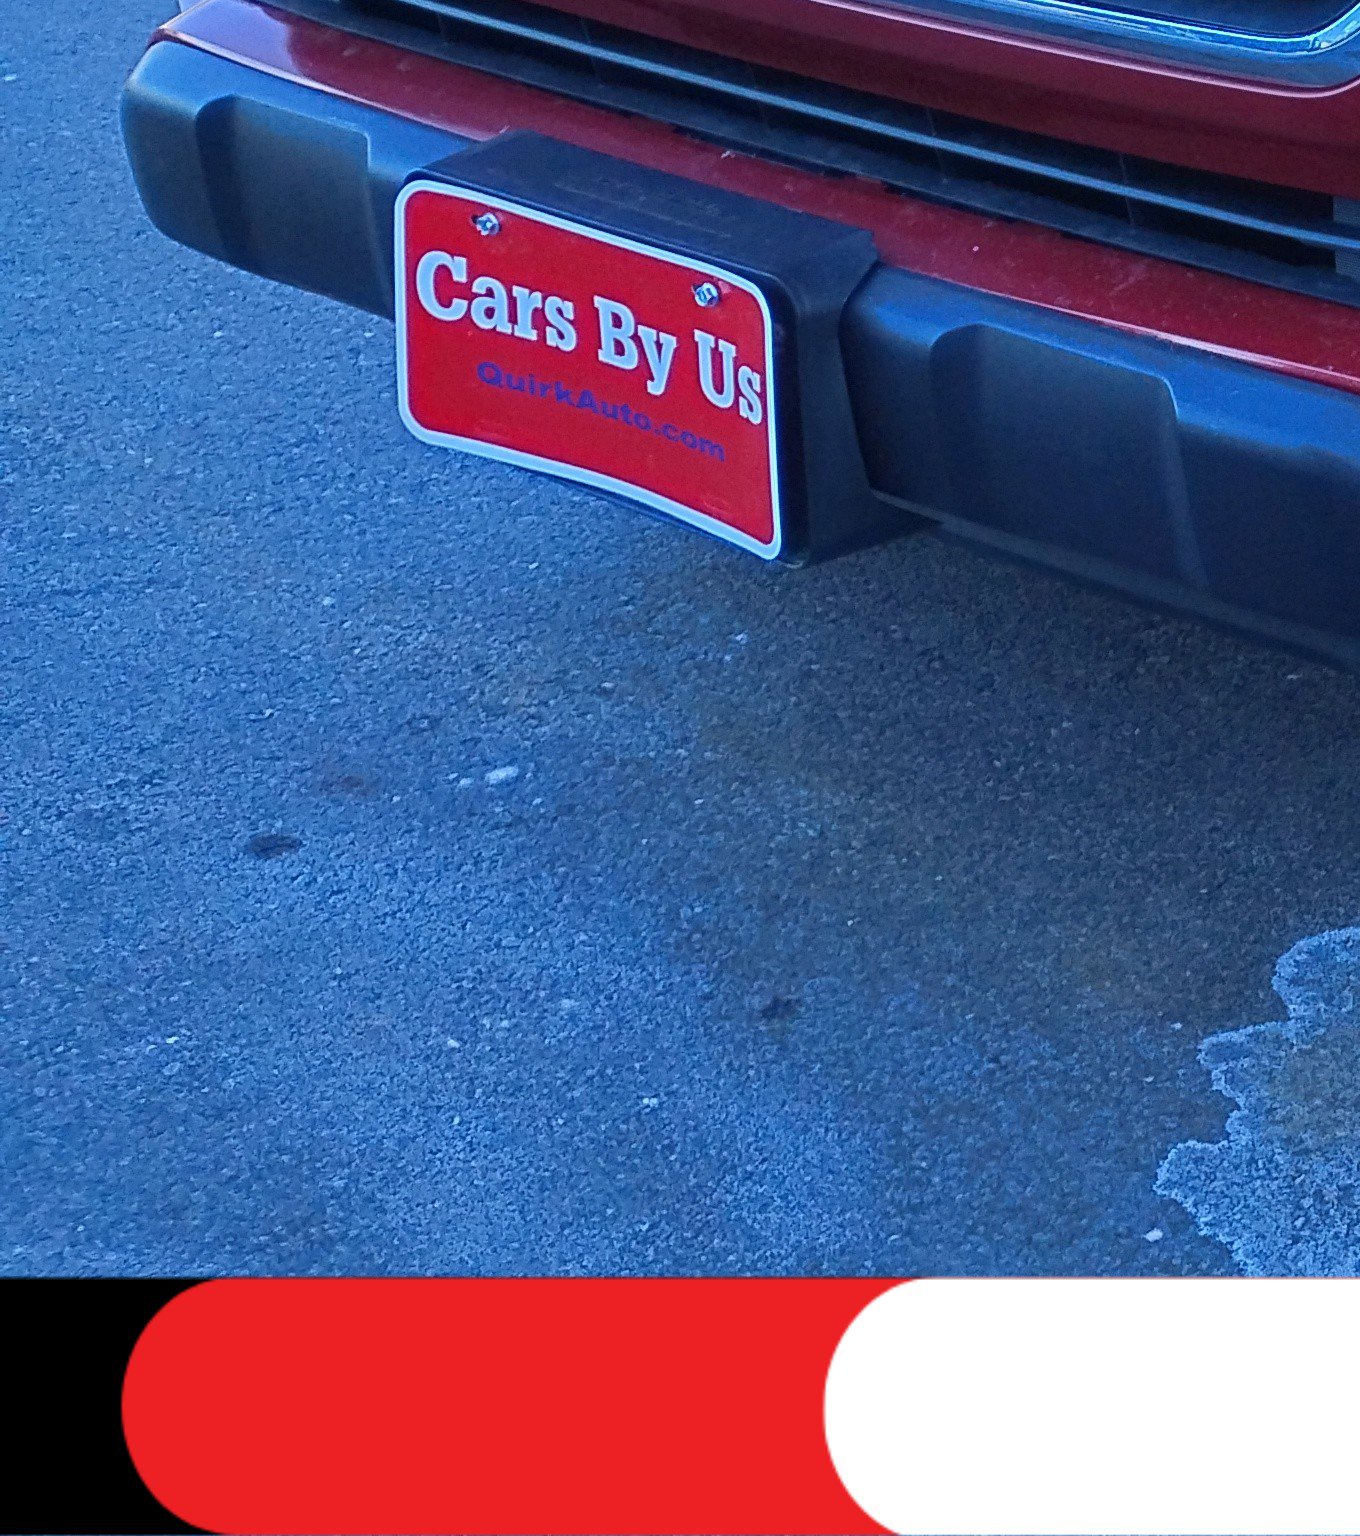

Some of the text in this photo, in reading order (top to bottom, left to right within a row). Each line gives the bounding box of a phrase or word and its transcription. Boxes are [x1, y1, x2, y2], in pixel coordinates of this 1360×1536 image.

[414, 249, 764, 426] Cars By Us
[476, 361, 726, 463] QuirkAuto.com
